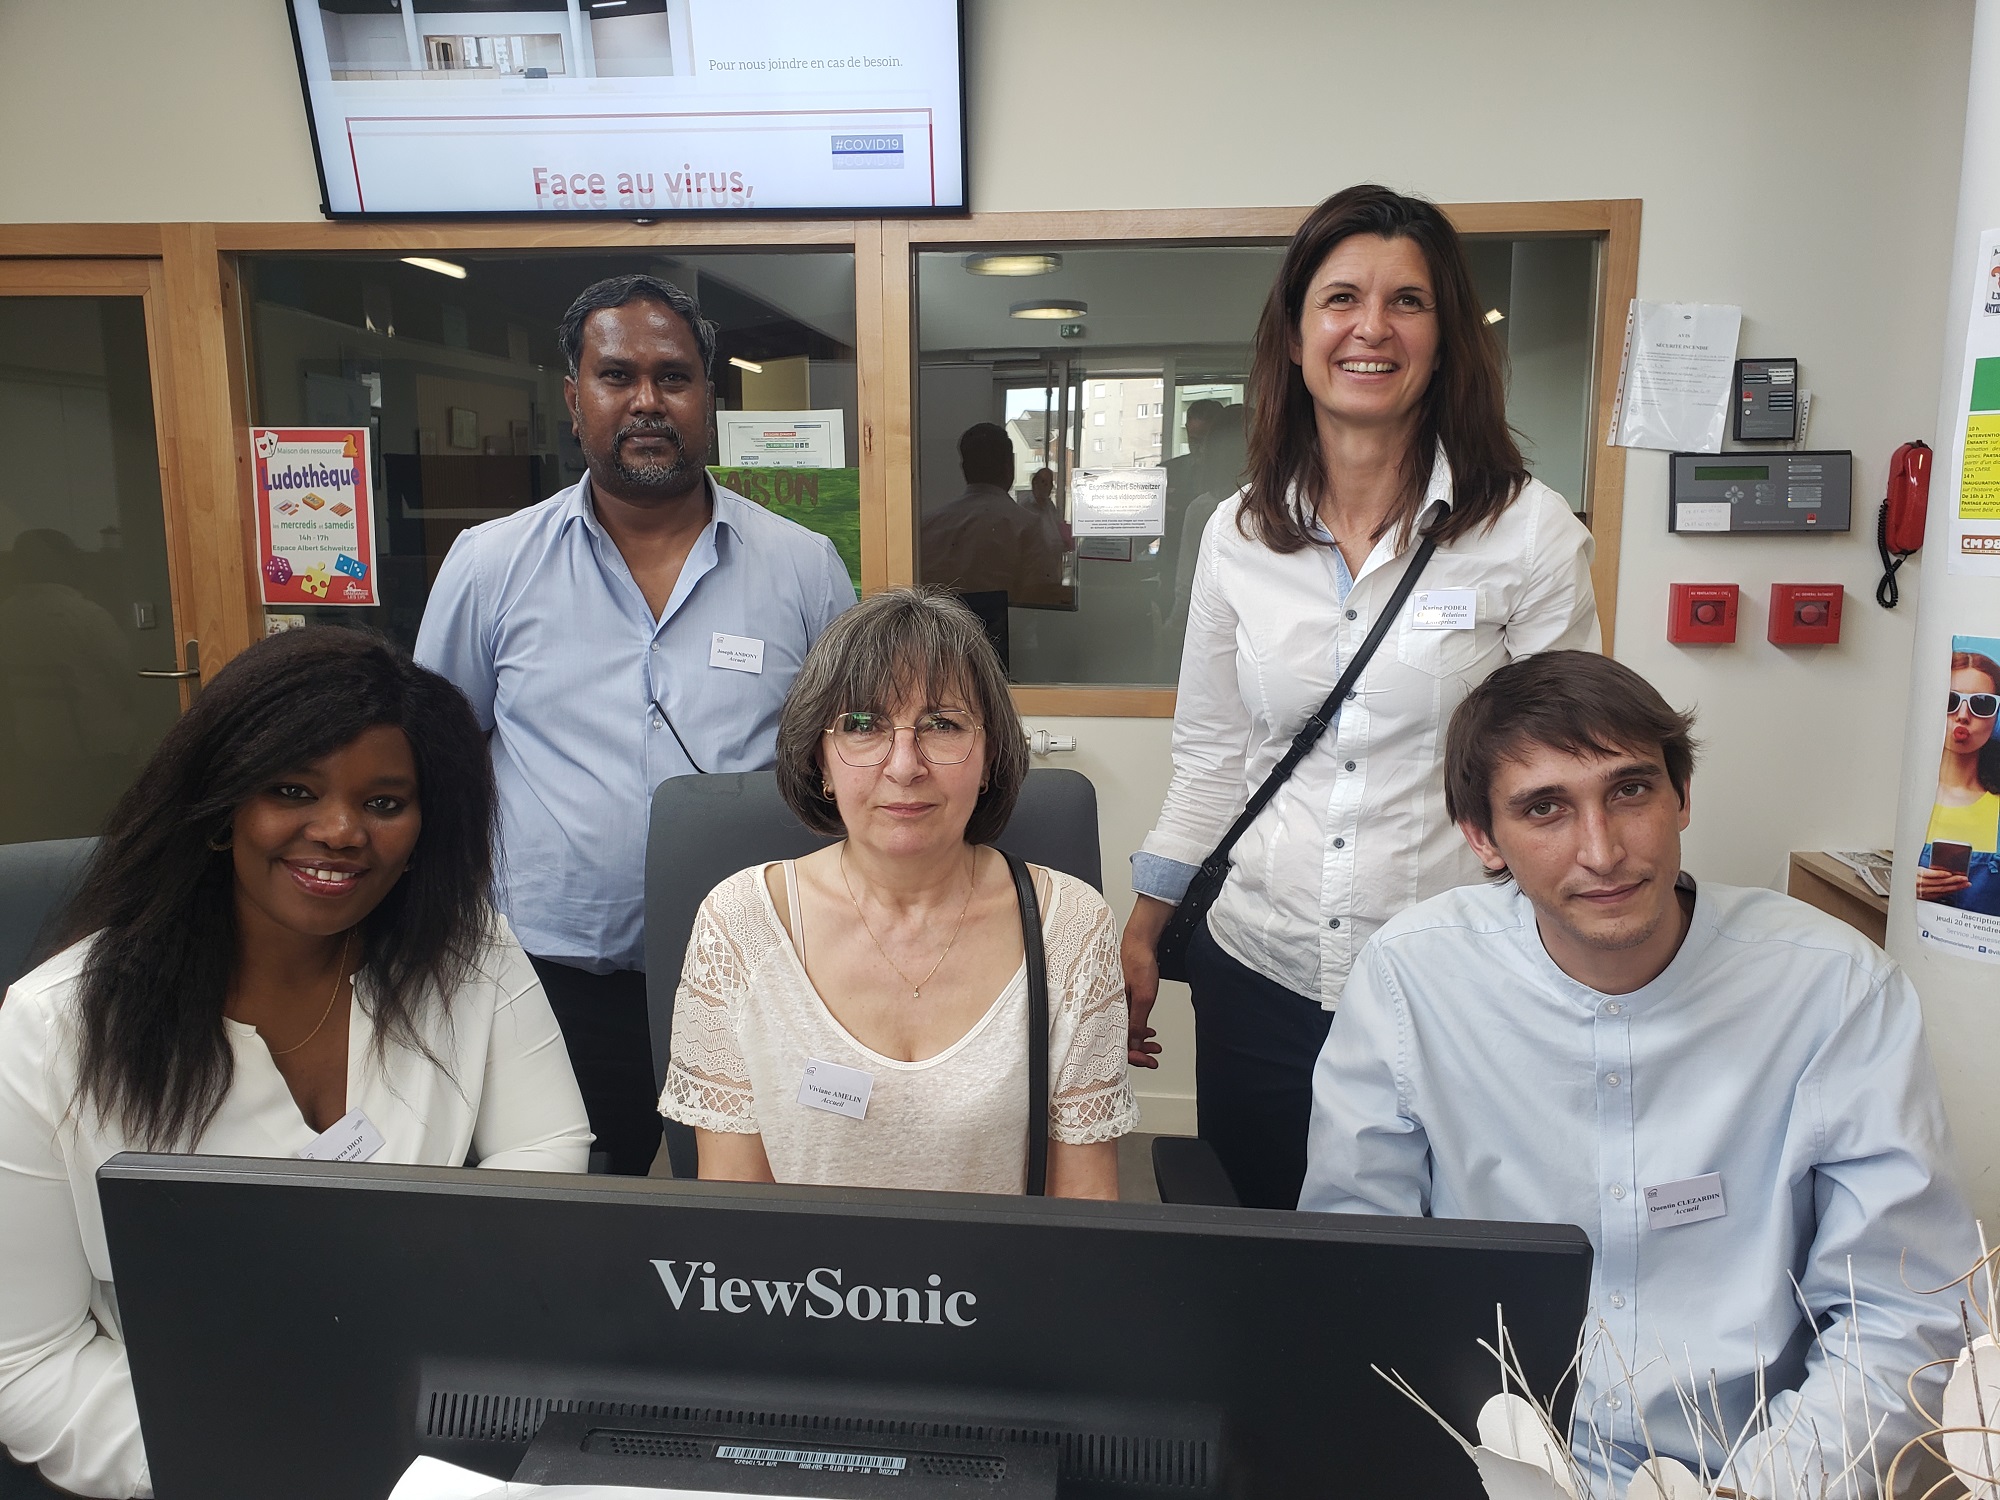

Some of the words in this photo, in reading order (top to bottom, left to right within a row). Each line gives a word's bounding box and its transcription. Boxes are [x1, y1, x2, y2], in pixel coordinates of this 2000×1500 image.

[709, 59, 736, 71] Pour
[739, 60, 766, 70] nous
[768, 58, 809, 71] joindre
[810, 60, 825, 69] en
[827, 59, 845, 68] cas
[847, 56, 861, 68] de
[863, 55, 903, 68] besoin.
[835, 138, 900, 151] #COVID19
[532, 167, 606, 195] Face
[616, 172, 654, 195] au
[663, 163, 754, 199] virus,
[277, 447, 299, 455] Maison
[261, 462, 360, 491] Ludothèque
[1129, 482, 1161, 490] Schweitzer
[280, 520, 317, 530] mercredis
[324, 520, 355, 530] samedis
[1954, 918, 1963, 926] 20
[1964, 920, 1971, 929] et
[809, 1084, 831, 1096] Viviane
[832, 1091, 862, 1103] AMELIN
[821, 1097, 845, 1108] Accueil
[346, 1135, 363, 1151] DIOP
[1650, 1203, 1676, 1213] Quentin
[1674, 1204, 1700, 1215] Accueil
[649, 1259, 978, 1327] ViewSonic
